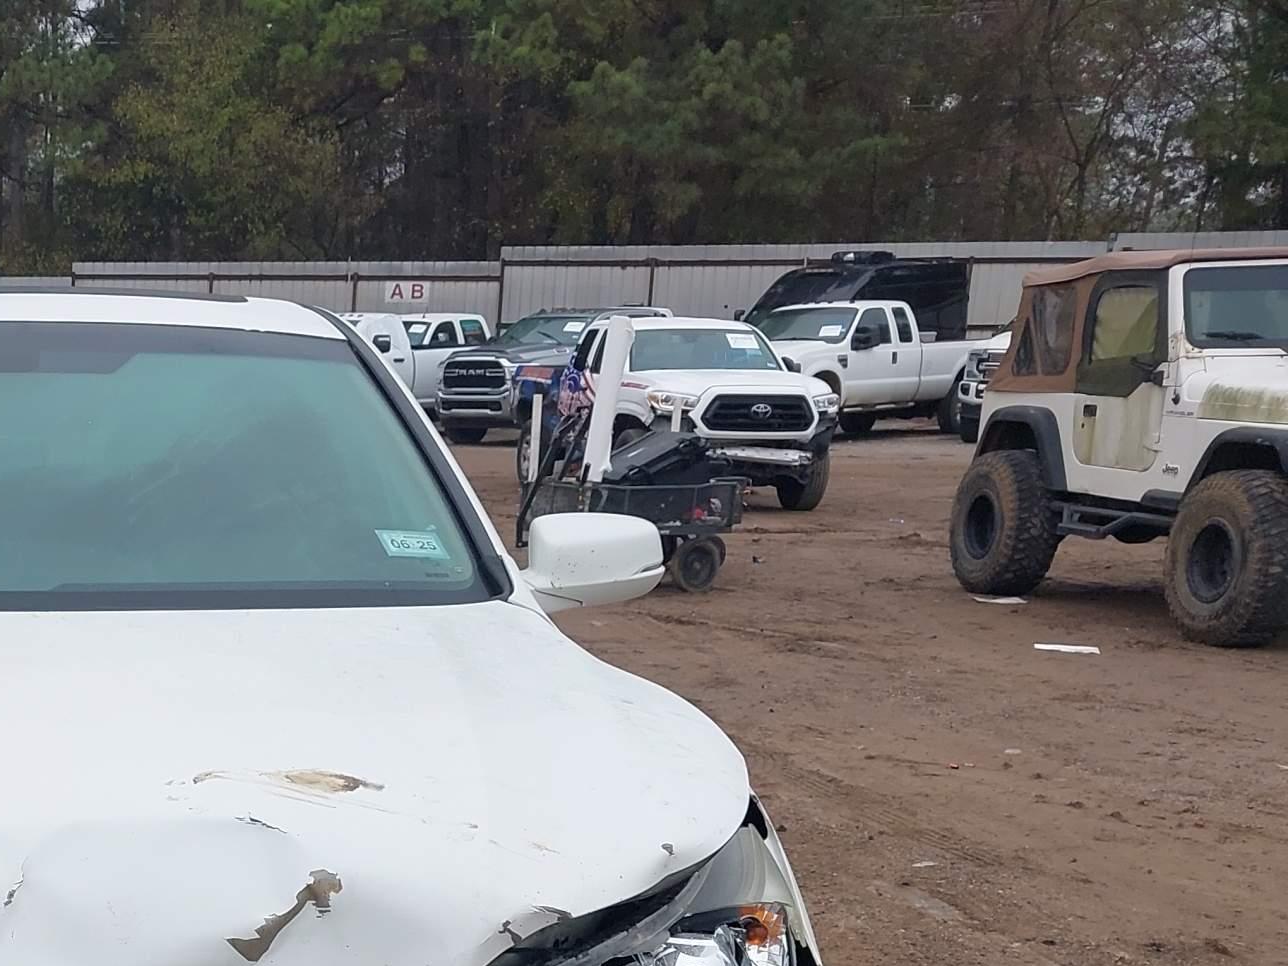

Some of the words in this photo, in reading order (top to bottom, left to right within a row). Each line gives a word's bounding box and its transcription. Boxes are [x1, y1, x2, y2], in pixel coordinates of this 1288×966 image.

[390, 283, 403, 299] A
[411, 283, 424, 299] B
[457, 368, 485, 377] RAM
[1162, 463, 1179, 477] Jeep
